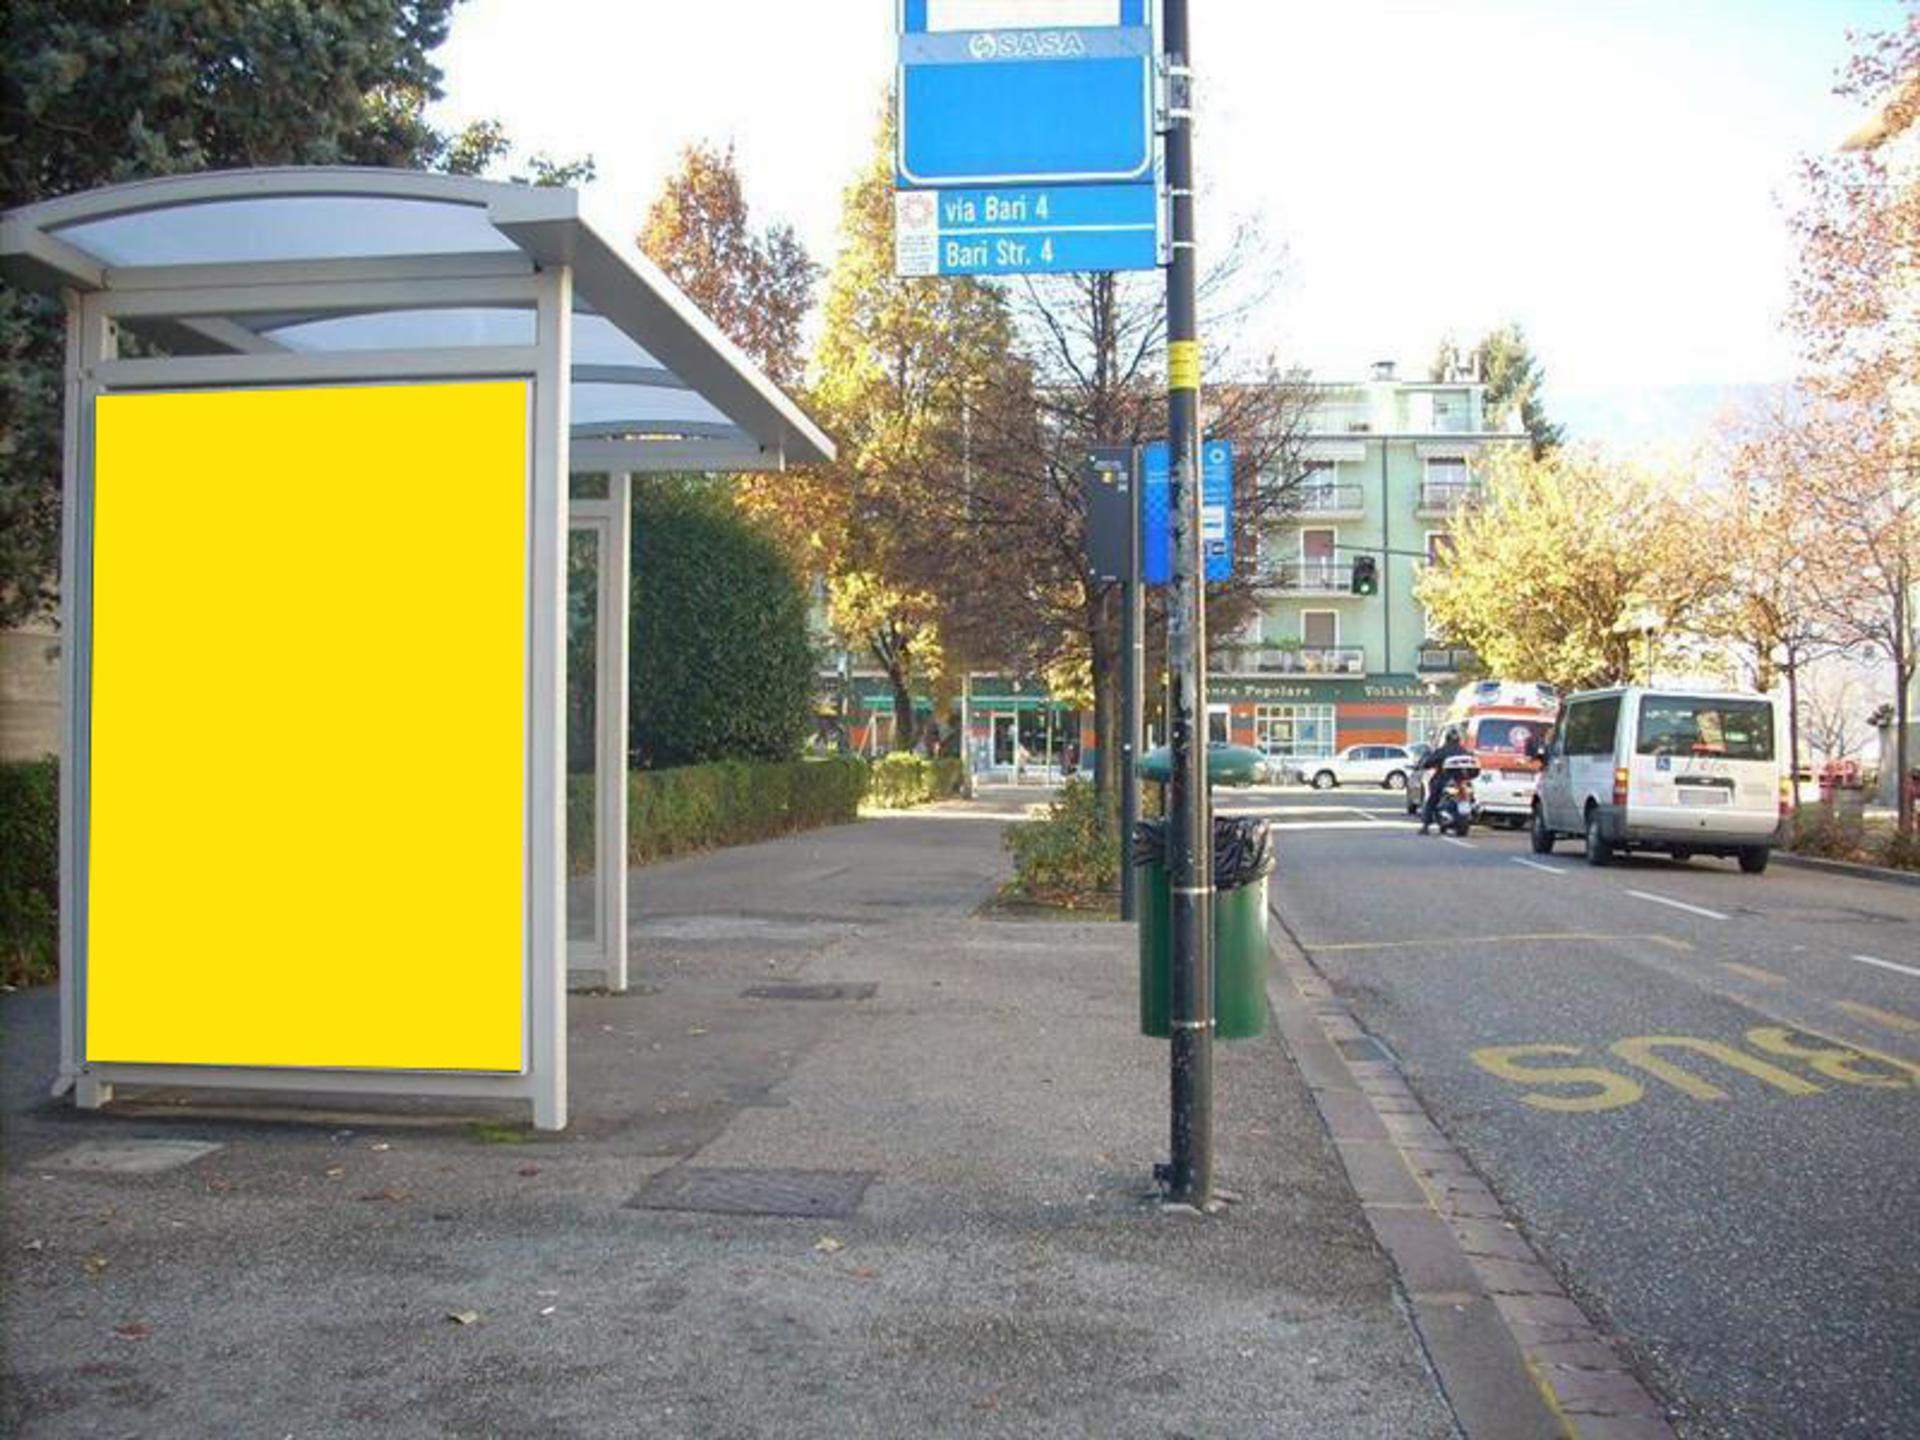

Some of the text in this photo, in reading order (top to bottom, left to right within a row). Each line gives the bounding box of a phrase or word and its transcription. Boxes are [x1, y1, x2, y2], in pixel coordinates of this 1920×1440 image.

[999, 32, 1085, 56] SASA
[945, 194, 1049, 222] via Bari 4
[946, 240, 988, 267] Bari
[996, 238, 1031, 265] Str.
[1041, 238, 1054, 262] 4
[1244, 685, 1312, 698] Popolare
[1470, 1024, 1918, 1112] BUS
